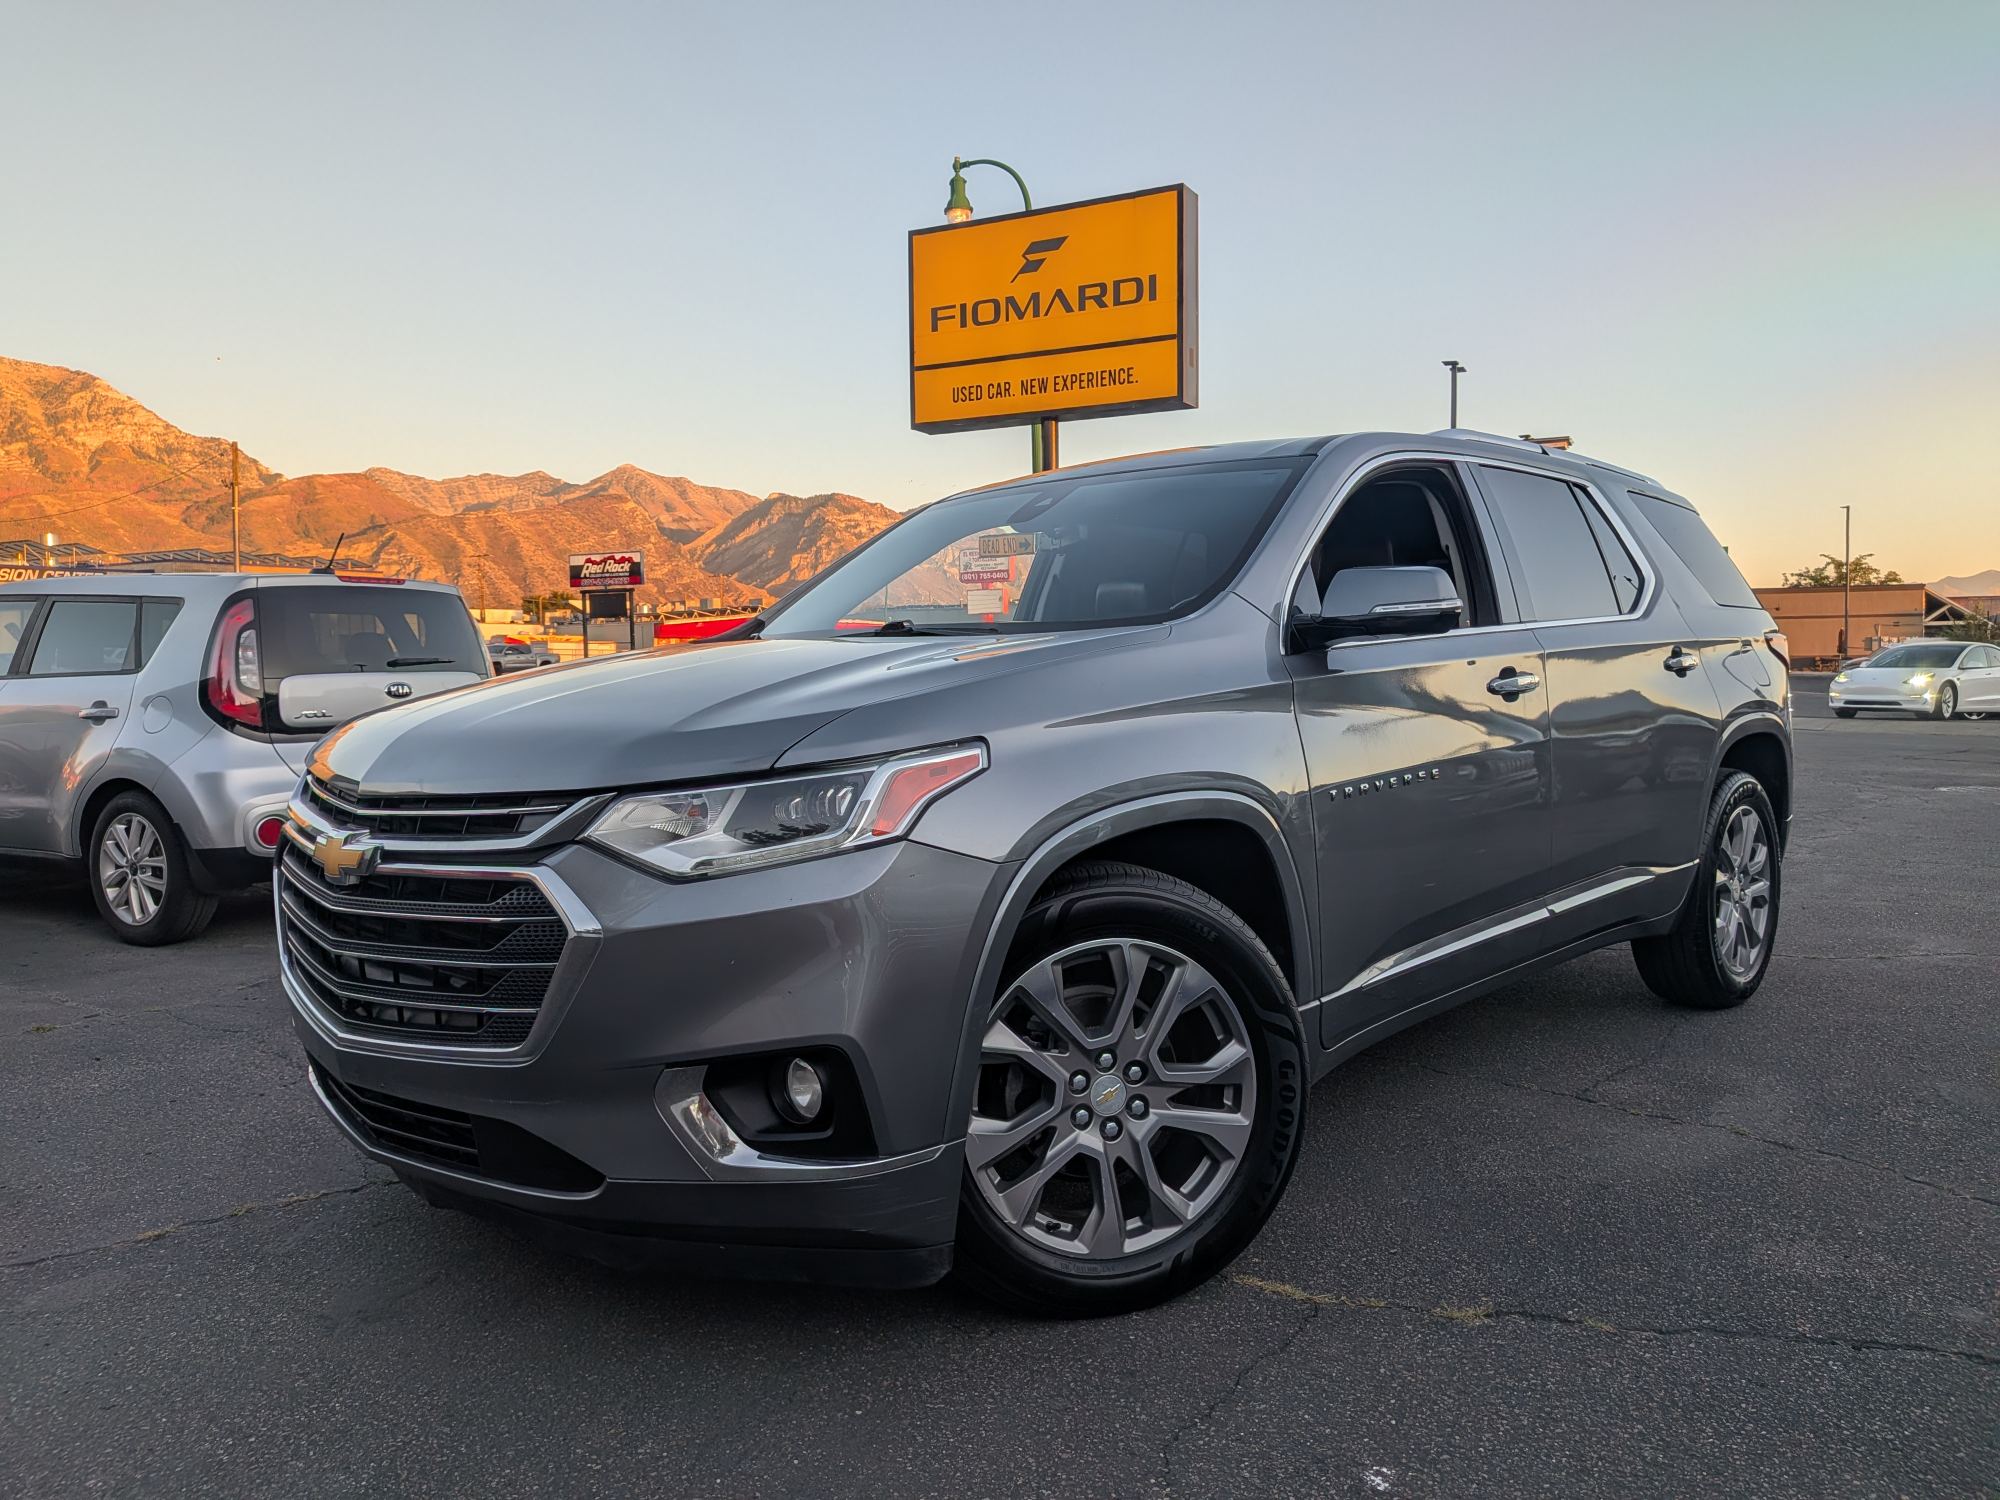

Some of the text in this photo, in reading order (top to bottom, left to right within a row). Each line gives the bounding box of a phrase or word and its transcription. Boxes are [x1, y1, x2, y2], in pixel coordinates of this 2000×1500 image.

[930, 274, 1157, 332] FIOMARDI
[952, 367, 1138, 403] USED CAR. NEW EXPERIENCE.
[982, 537, 1017, 554] DEAD END
[580, 562, 605, 578] Red
[604, 560, 632, 573] Rock
